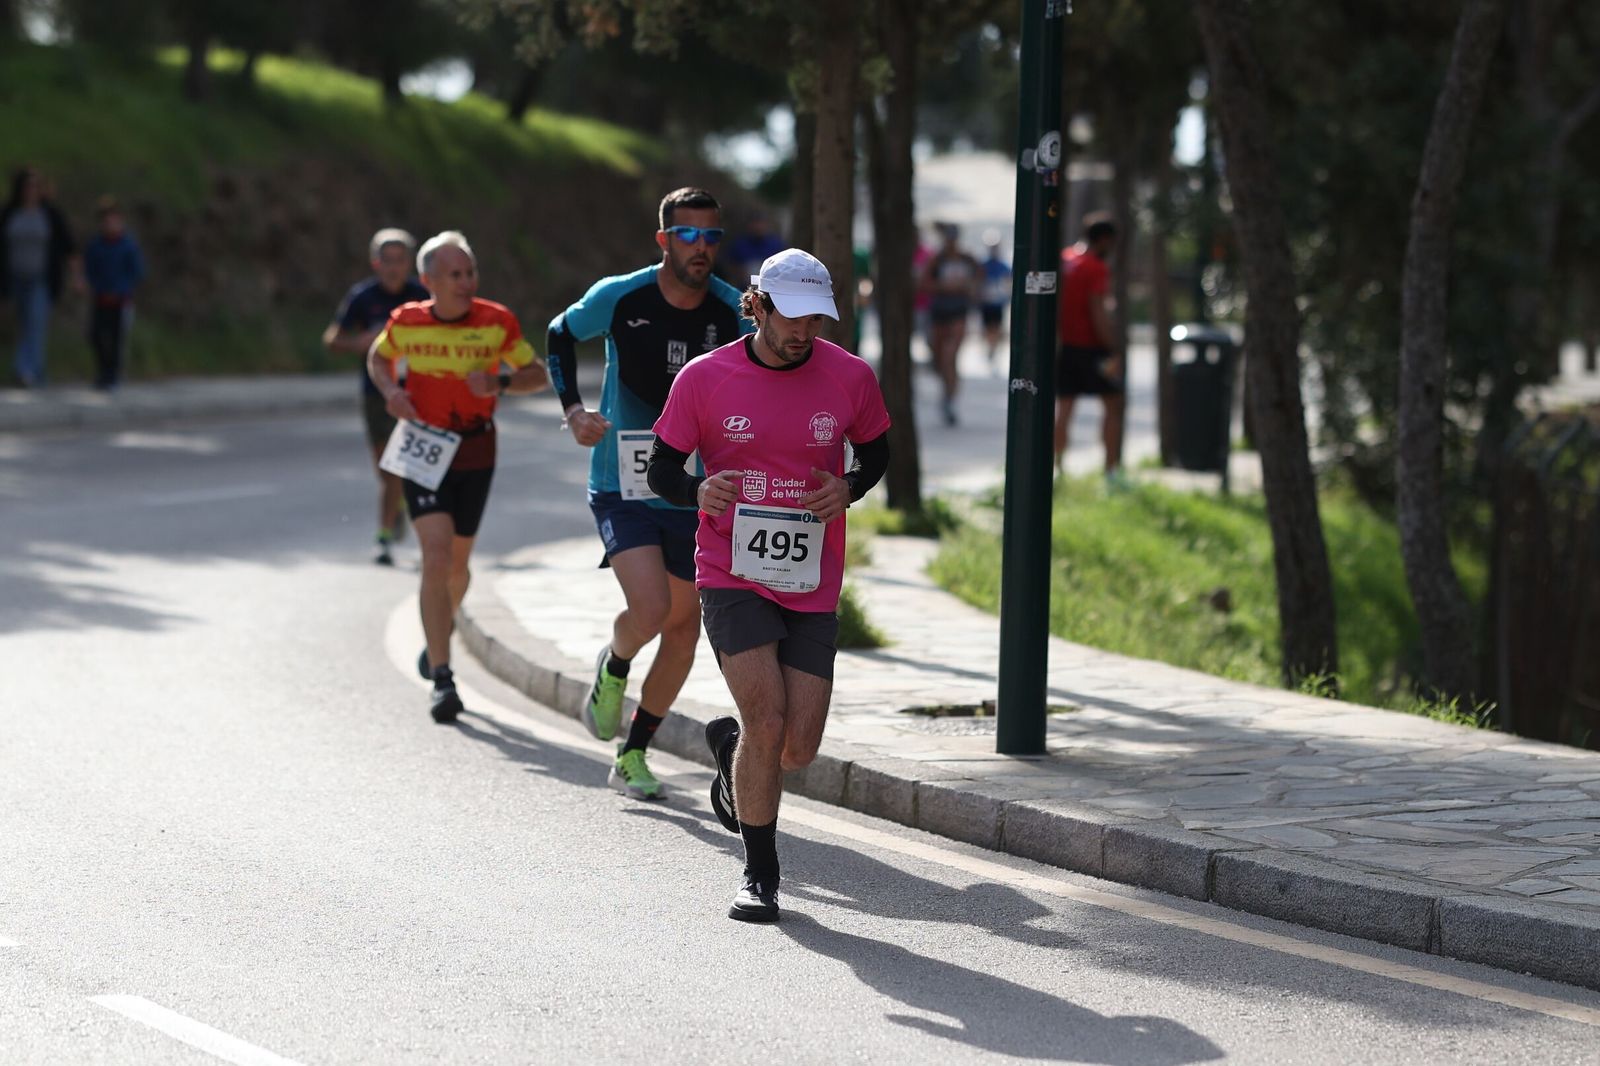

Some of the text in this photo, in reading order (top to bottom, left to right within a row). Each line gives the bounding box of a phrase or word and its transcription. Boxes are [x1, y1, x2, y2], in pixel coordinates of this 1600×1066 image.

[400, 431, 443, 466] 358
[771, 478, 806, 488] Ciudad
[771, 489, 784, 498] de
[747, 529, 809, 562] 495
